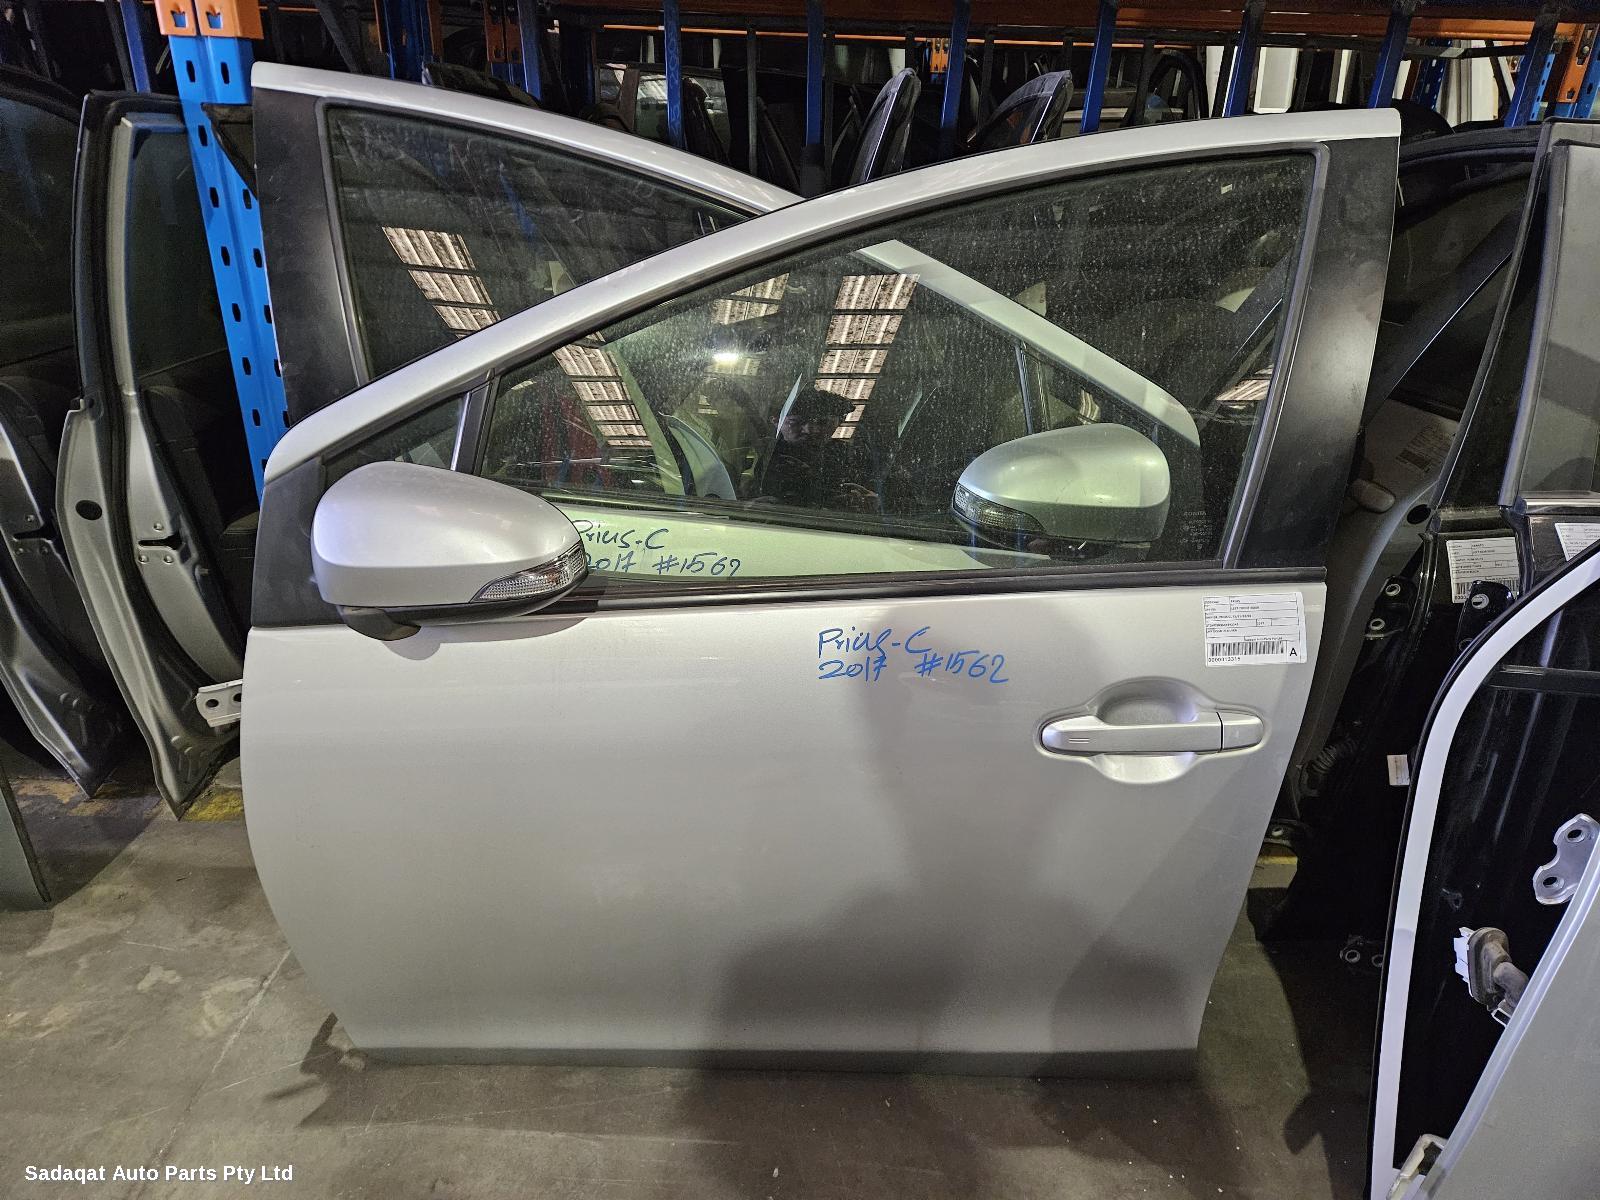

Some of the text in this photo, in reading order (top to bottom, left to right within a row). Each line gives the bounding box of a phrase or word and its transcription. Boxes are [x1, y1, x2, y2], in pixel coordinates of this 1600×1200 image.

[1289, 647, 1298, 657] A
[818, 649, 1009, 683] 2017 #1562
